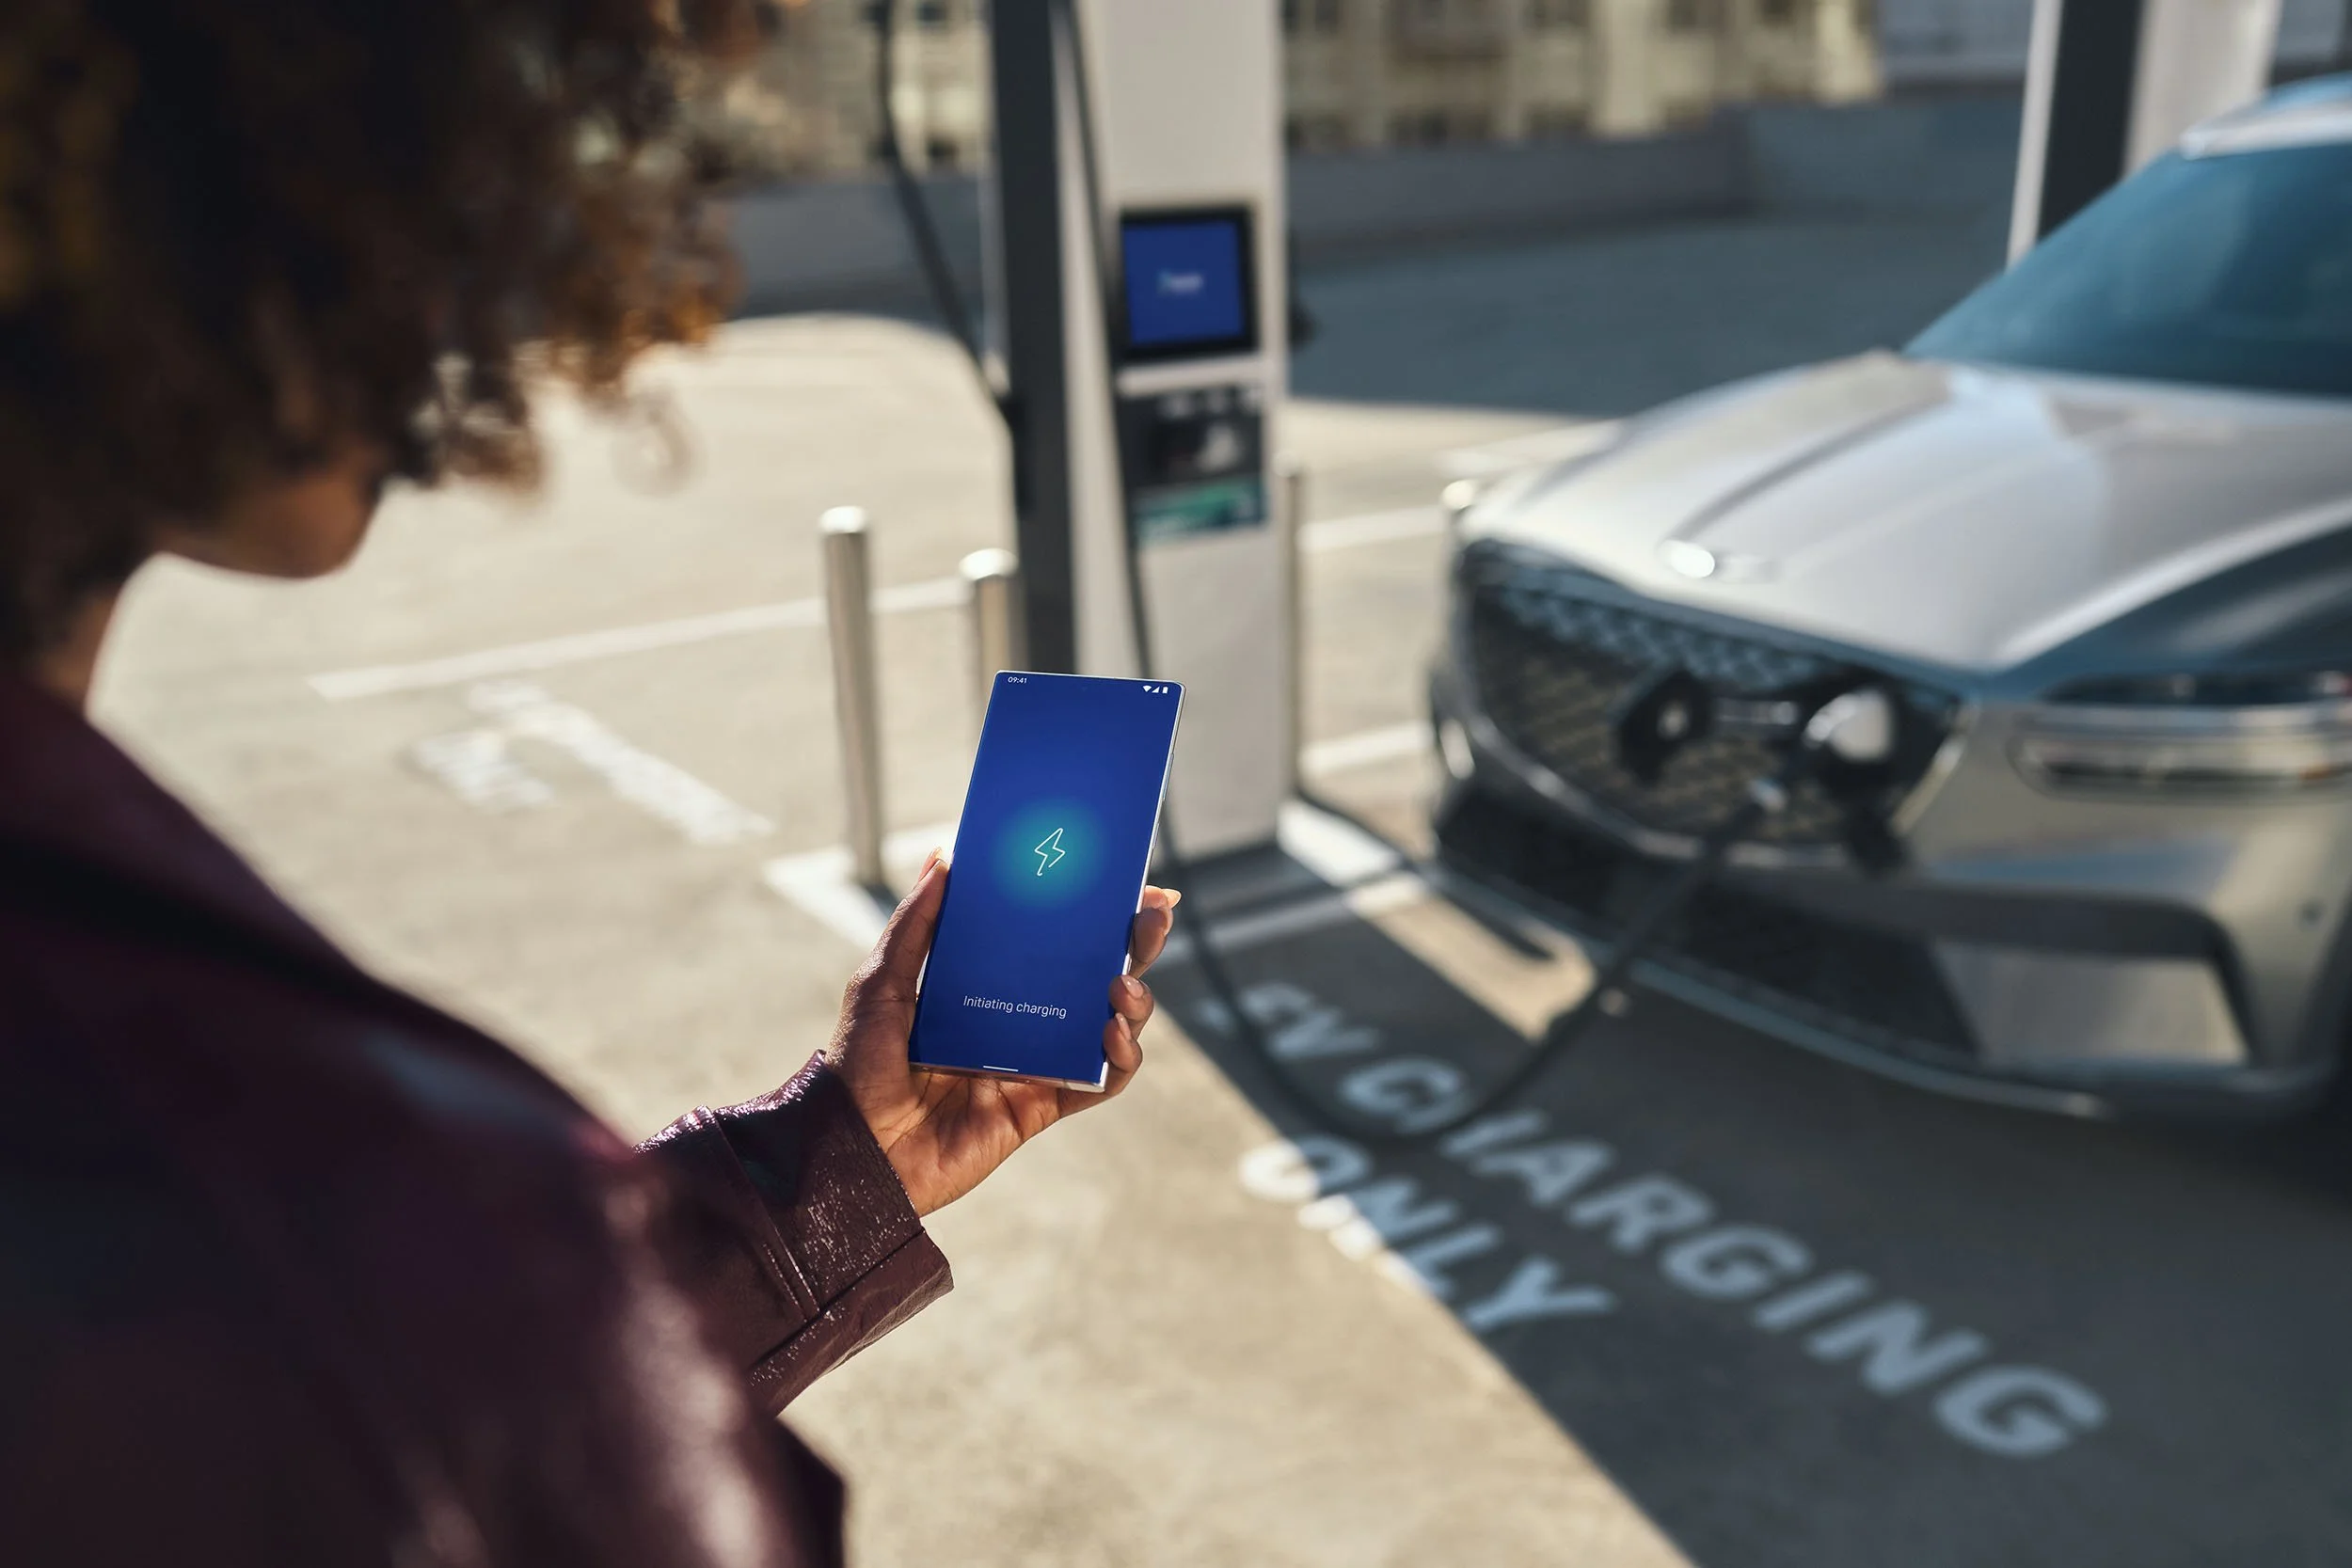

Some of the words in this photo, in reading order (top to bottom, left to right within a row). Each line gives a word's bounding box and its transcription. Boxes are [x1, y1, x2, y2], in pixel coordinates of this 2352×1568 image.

[962, 995, 1013, 1014] Initiating
[1016, 1002, 1068, 1020] charging
[1238, 1133, 1611, 1327] ONLY
